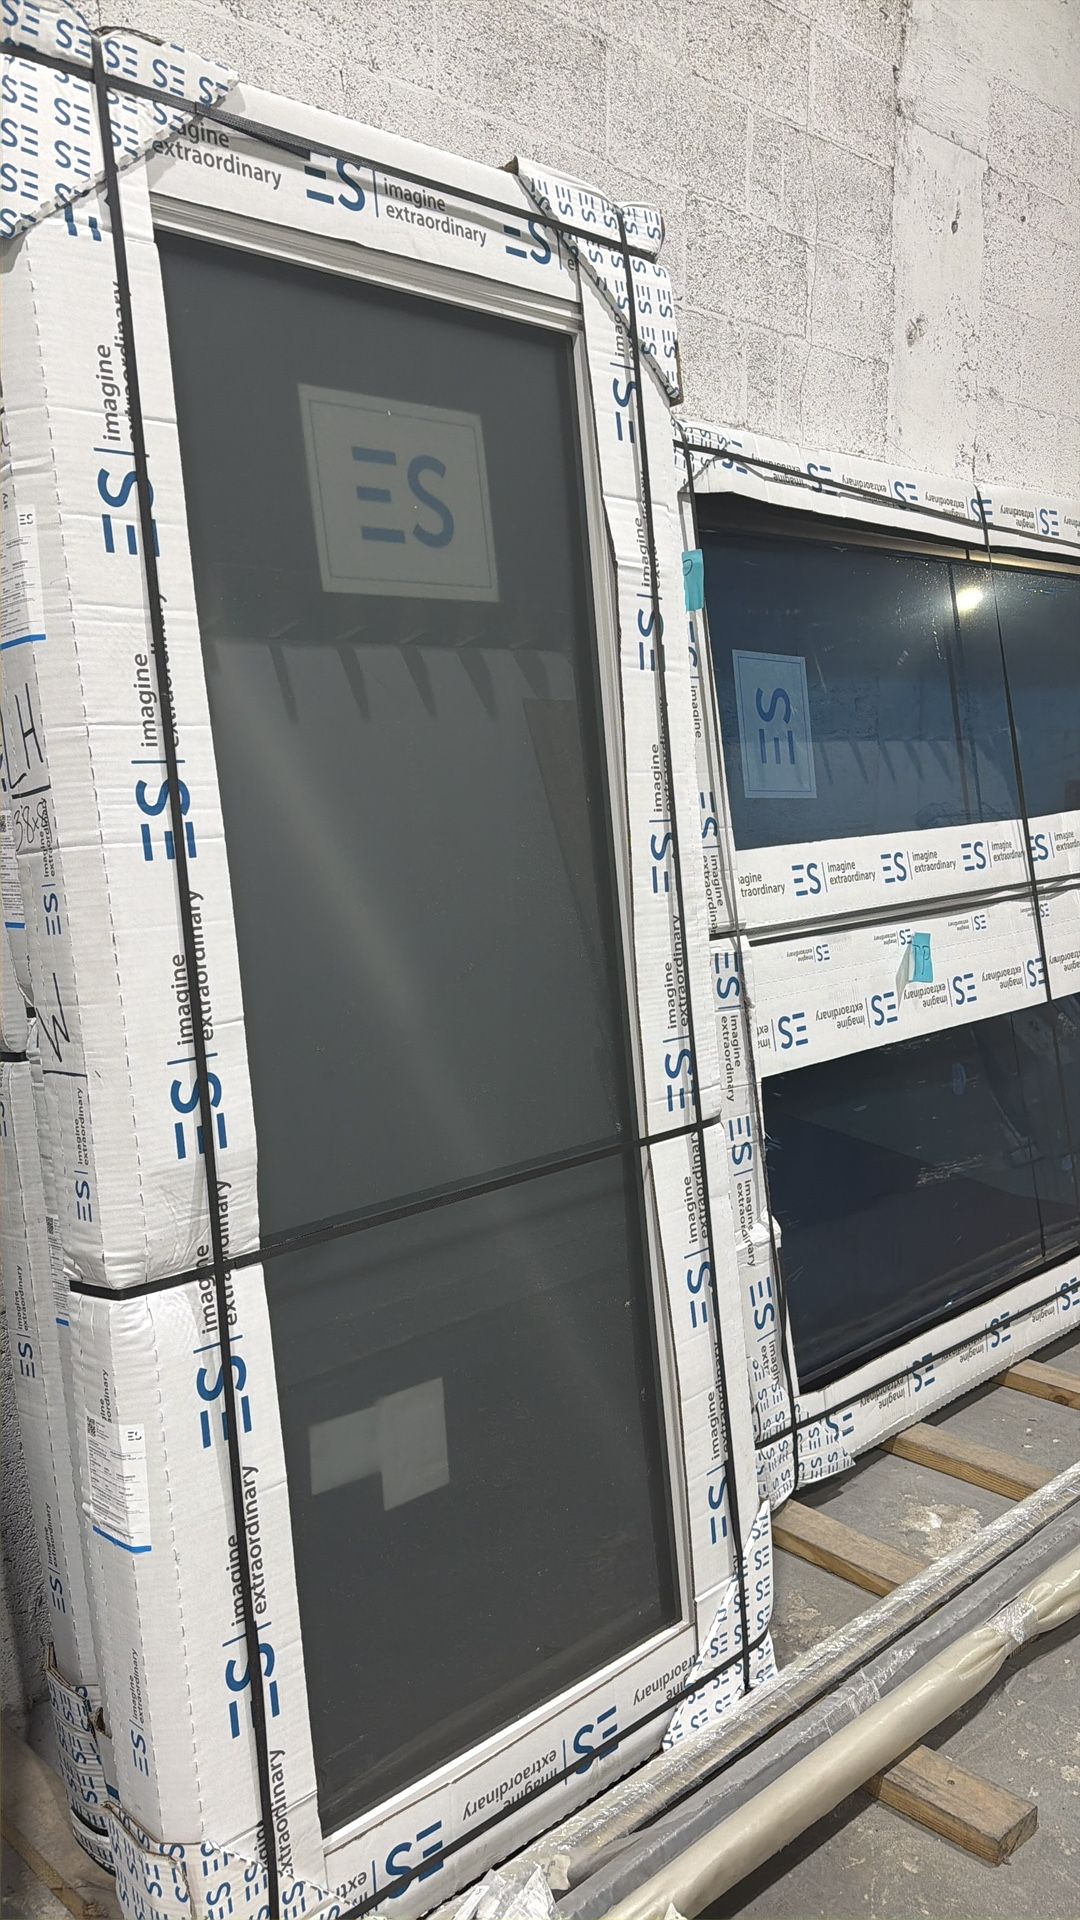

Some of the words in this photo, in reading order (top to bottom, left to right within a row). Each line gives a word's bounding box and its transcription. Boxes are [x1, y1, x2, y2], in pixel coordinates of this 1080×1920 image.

[152, 58, 185, 97] ES
[1, 118, 38, 157] ES
[54, 97, 91, 136] ES
[177, 123, 230, 149] agine
[54, 140, 91, 178] ES
[152, 138, 282, 190] extraordinary
[1, 163, 39, 202] ES
[383, 177, 446, 213] imagine
[555, 185, 573, 218] ES
[386, 203, 487, 248] extraordinary
[579, 193, 597, 224] ES
[636, 285, 652, 314] ES
[657, 288, 673, 318] ES
[95, 344, 121, 442] imagine
[97, 467, 160, 558] ES
[352, 446, 454, 548] ES
[1039, 508, 1060, 536] ES
[634, 516, 649, 588] imagine
[133, 653, 158, 748] imagine
[690, 685, 702, 738] imagine
[756, 687, 795, 765] ES
[650, 743, 663, 812] imagine
[135, 778, 198, 862] ES
[911, 850, 938, 862] imagine
[914, 859, 957, 874] extraordinary
[960, 841, 986, 872] ES
[991, 840, 1013, 851] imagine
[710, 854, 724, 907] imagine
[792, 863, 821, 896] ES
[827, 861, 856, 874] imagine
[829, 871, 876, 886] extraordinary
[880, 852, 907, 884] ES
[702, 855, 717, 934] extraordinar
[741, 882, 785, 898] traordinary
[44, 892, 61, 935] ES
[974, 914, 987, 931] ES
[816, 943, 831, 962] ES
[899, 928, 912, 946] ES
[672, 914, 690, 1028] extraordinary
[715, 952, 741, 1000] ES
[904, 983, 946, 1000] extraordinary
[953, 973, 978, 1006] ES
[981, 965, 1022, 983] extraordinary
[1000, 977, 1024, 990] imagine
[171, 954, 194, 1045] imagine
[664, 962, 678, 1029] imagine
[815, 1002, 864, 1021] extraordinary
[871, 991, 898, 1026] ES
[922, 994, 948, 1008] imagine
[729, 1014, 742, 1068] imagine
[778, 1012, 809, 1050] ES
[837, 1016, 865, 1030] imagine
[664, 1048, 696, 1112] ES
[721, 1015, 735, 1103] extraordinary
[76, 1087, 89, 1166] extraordinary
[170, 1071, 228, 1160] ES
[74, 1118, 83, 1165] imagine
[728, 1115, 753, 1166] ES
[75, 1180, 93, 1223] ES
[684, 1176, 698, 1243] imagine
[743, 1179, 755, 1231] imagine
[737, 1182, 756, 1267] extraordinary
[750, 1277, 775, 1330] ES
[1031, 1306, 1055, 1323] imagine
[18, 1342, 35, 1378] ES
[958, 1344, 985, 1364] imagine
[196, 1355, 252, 1449] ES
[878, 1389, 906, 1410] imagine
[707, 1391, 720, 1461] imagine
[242, 1465, 268, 1616] extraordinary
[50, 1577, 66, 1614] ES
[225, 1535, 246, 1628] imagine
[710, 1632, 728, 1658] ES
[130, 1675, 138, 1720] imagine
[132, 1648, 145, 1724] extraordinary
[131, 1729, 149, 1777] ES
[573, 1704, 618, 1776] ES
[462, 1748, 557, 1822] extraordinary
[385, 1819, 444, 1899] ES
